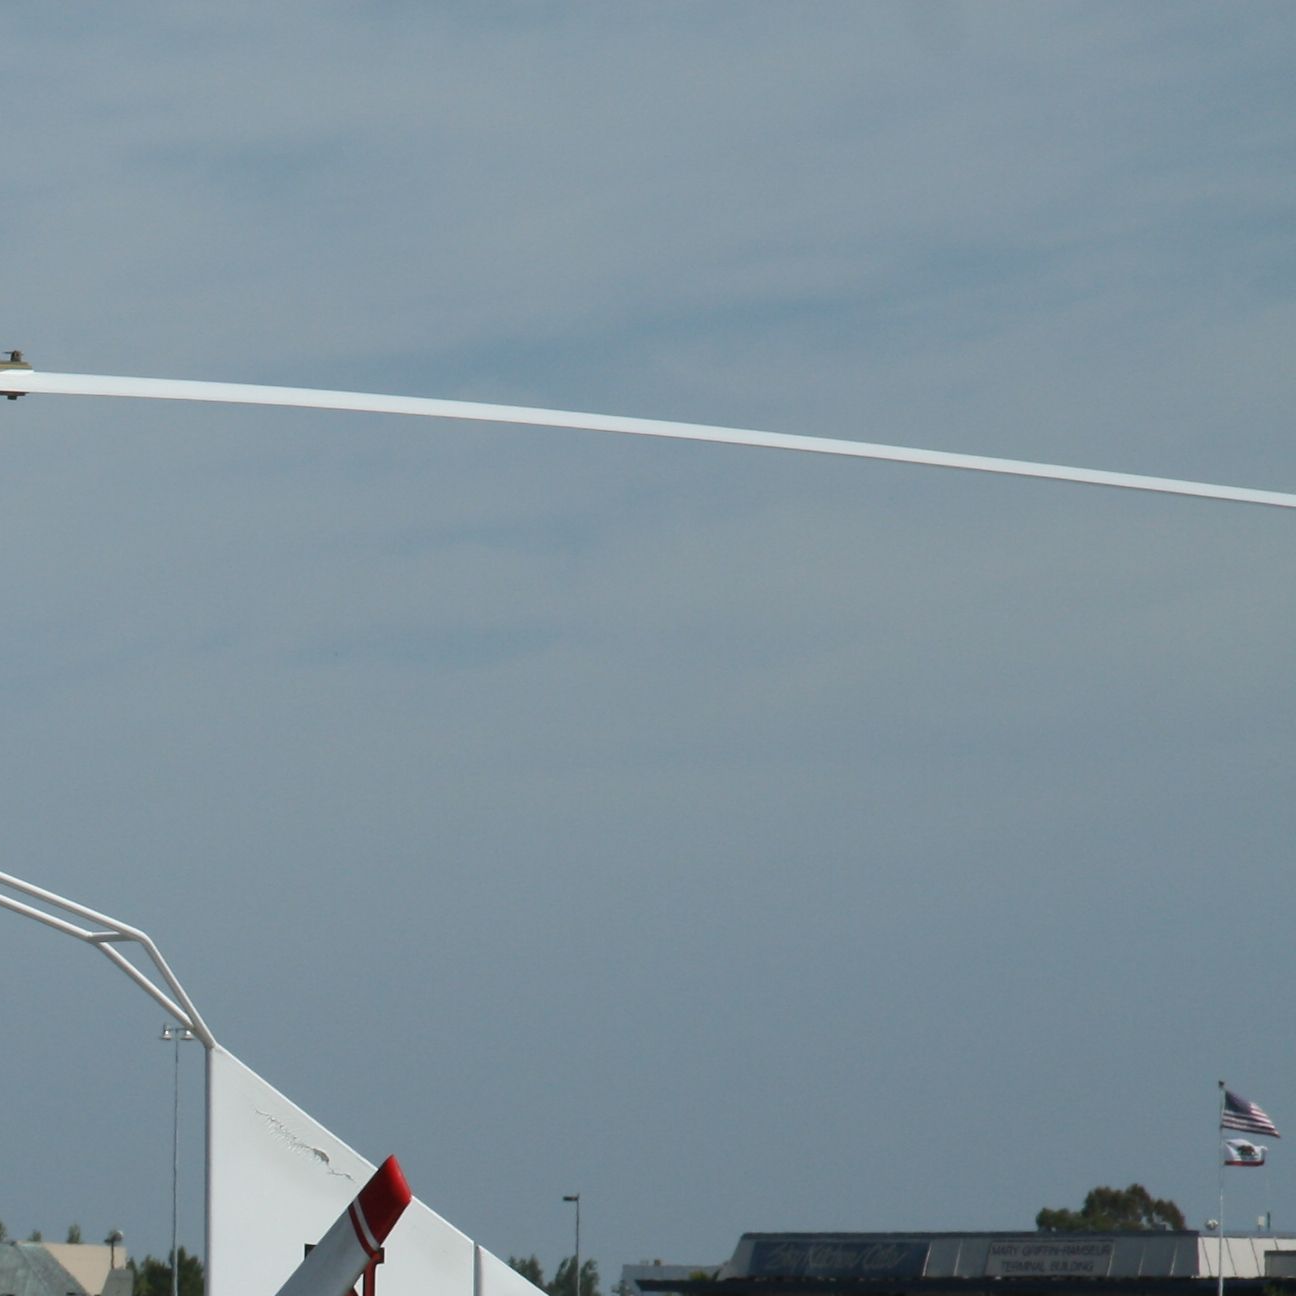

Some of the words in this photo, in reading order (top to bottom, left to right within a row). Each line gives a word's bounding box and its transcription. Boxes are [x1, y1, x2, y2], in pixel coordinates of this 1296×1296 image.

[992, 1245, 1018, 1256] MARY
[1002, 1261, 1045, 1272] TERMINAL
[1050, 1261, 1094, 1272] BUILDING
